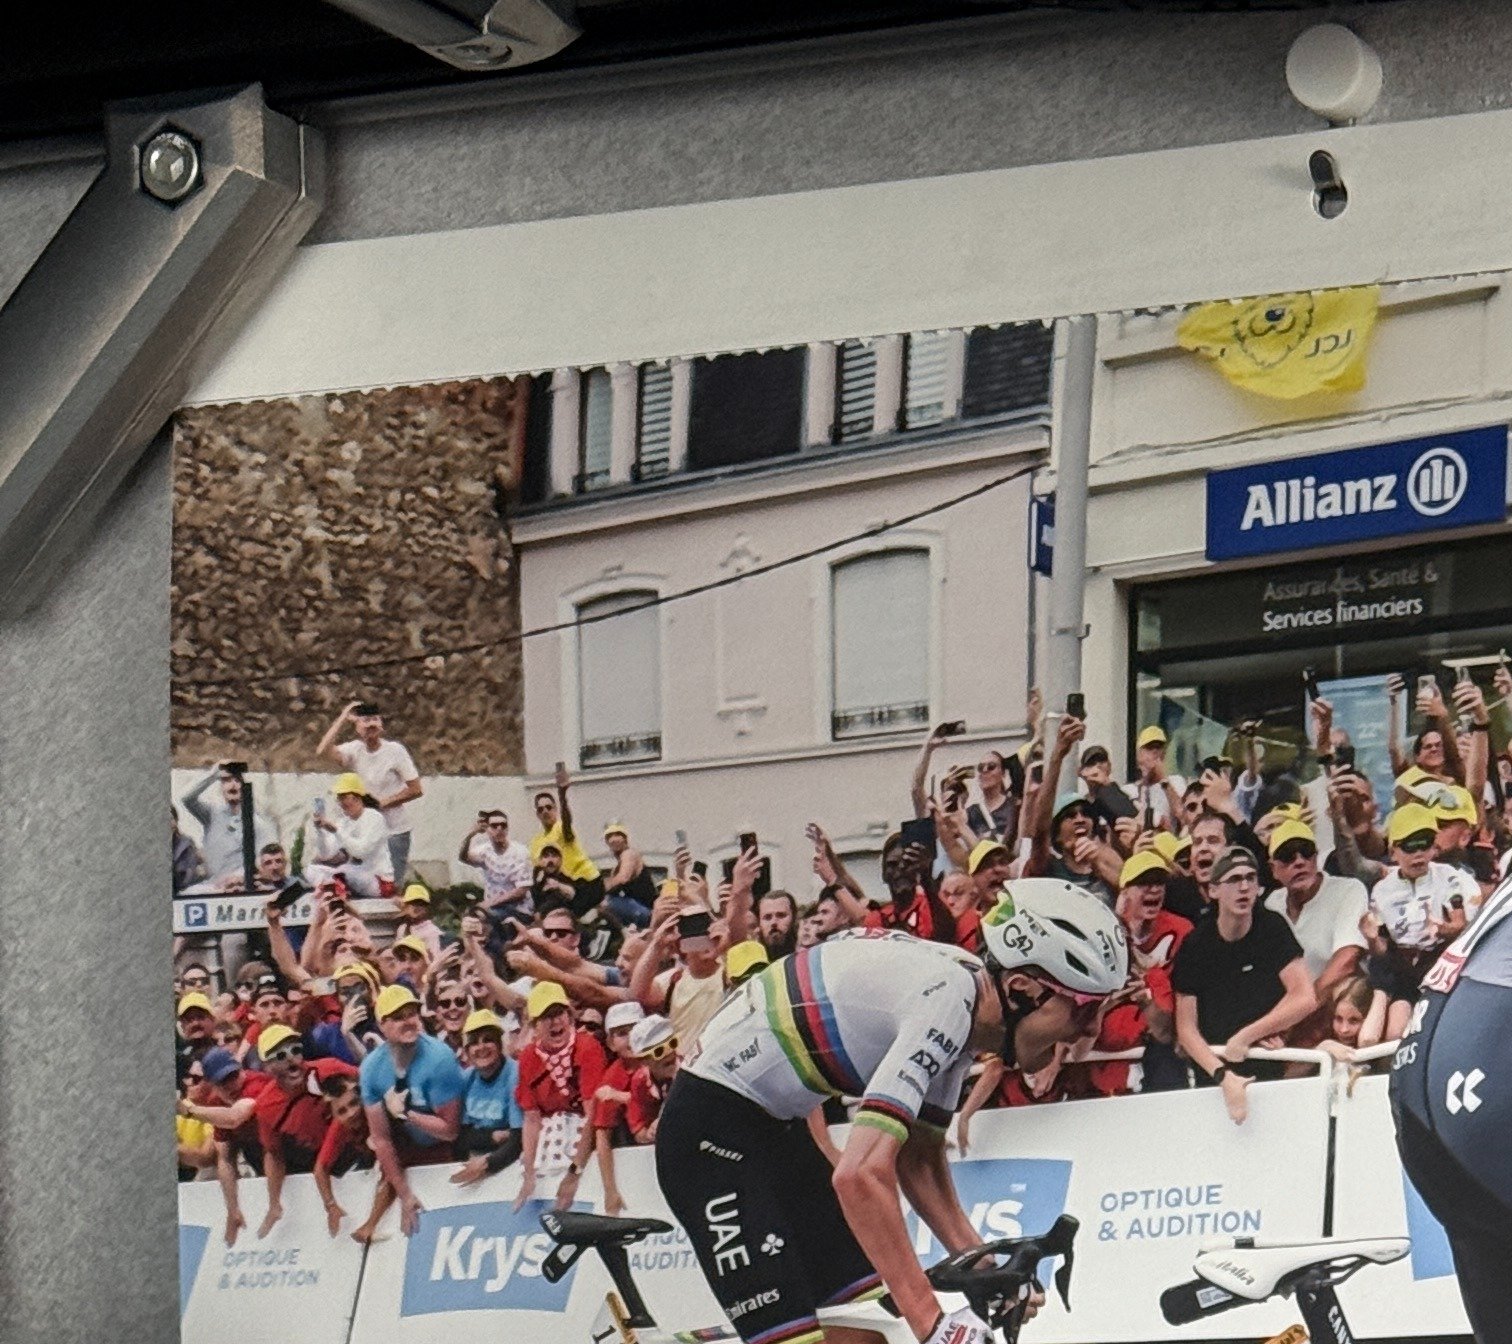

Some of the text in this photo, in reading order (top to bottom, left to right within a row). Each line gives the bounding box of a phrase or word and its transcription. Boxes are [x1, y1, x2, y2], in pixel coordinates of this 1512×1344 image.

[1240, 474, 1398, 531] Allianz
[1262, 595, 1424, 632] Services financiers
[1099, 1184, 1223, 1213] OPTIQUE
[704, 1191, 751, 1277] UAE
[1097, 1209, 1262, 1242] & AUDITION
[428, 1213, 553, 1293] Krys
